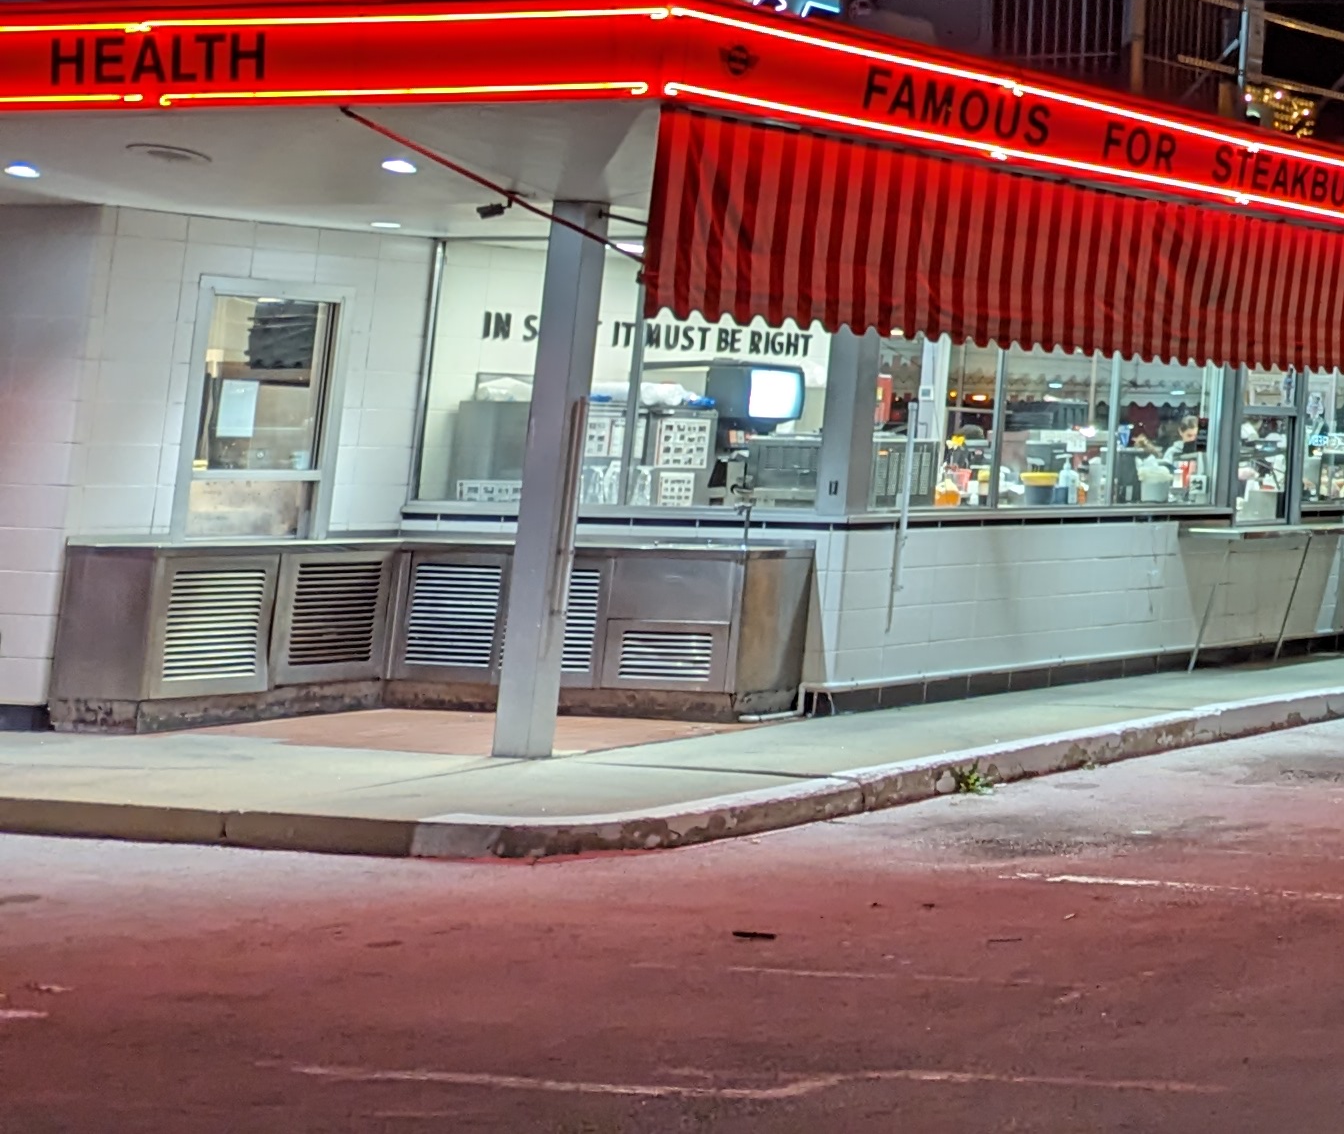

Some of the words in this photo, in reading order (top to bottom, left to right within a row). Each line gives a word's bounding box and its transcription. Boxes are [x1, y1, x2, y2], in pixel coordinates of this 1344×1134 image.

[51, 32, 266, 85] HEALTH
[862, 65, 1050, 147] FAMOUS
[1103, 120, 1177, 173] FOR
[482, 311, 511, 340] IN
[612, 321, 635, 347] IT
[645, 325, 711, 350] MUST
[717, 327, 743, 354] BE
[749, 331, 813, 357] RIGHT
